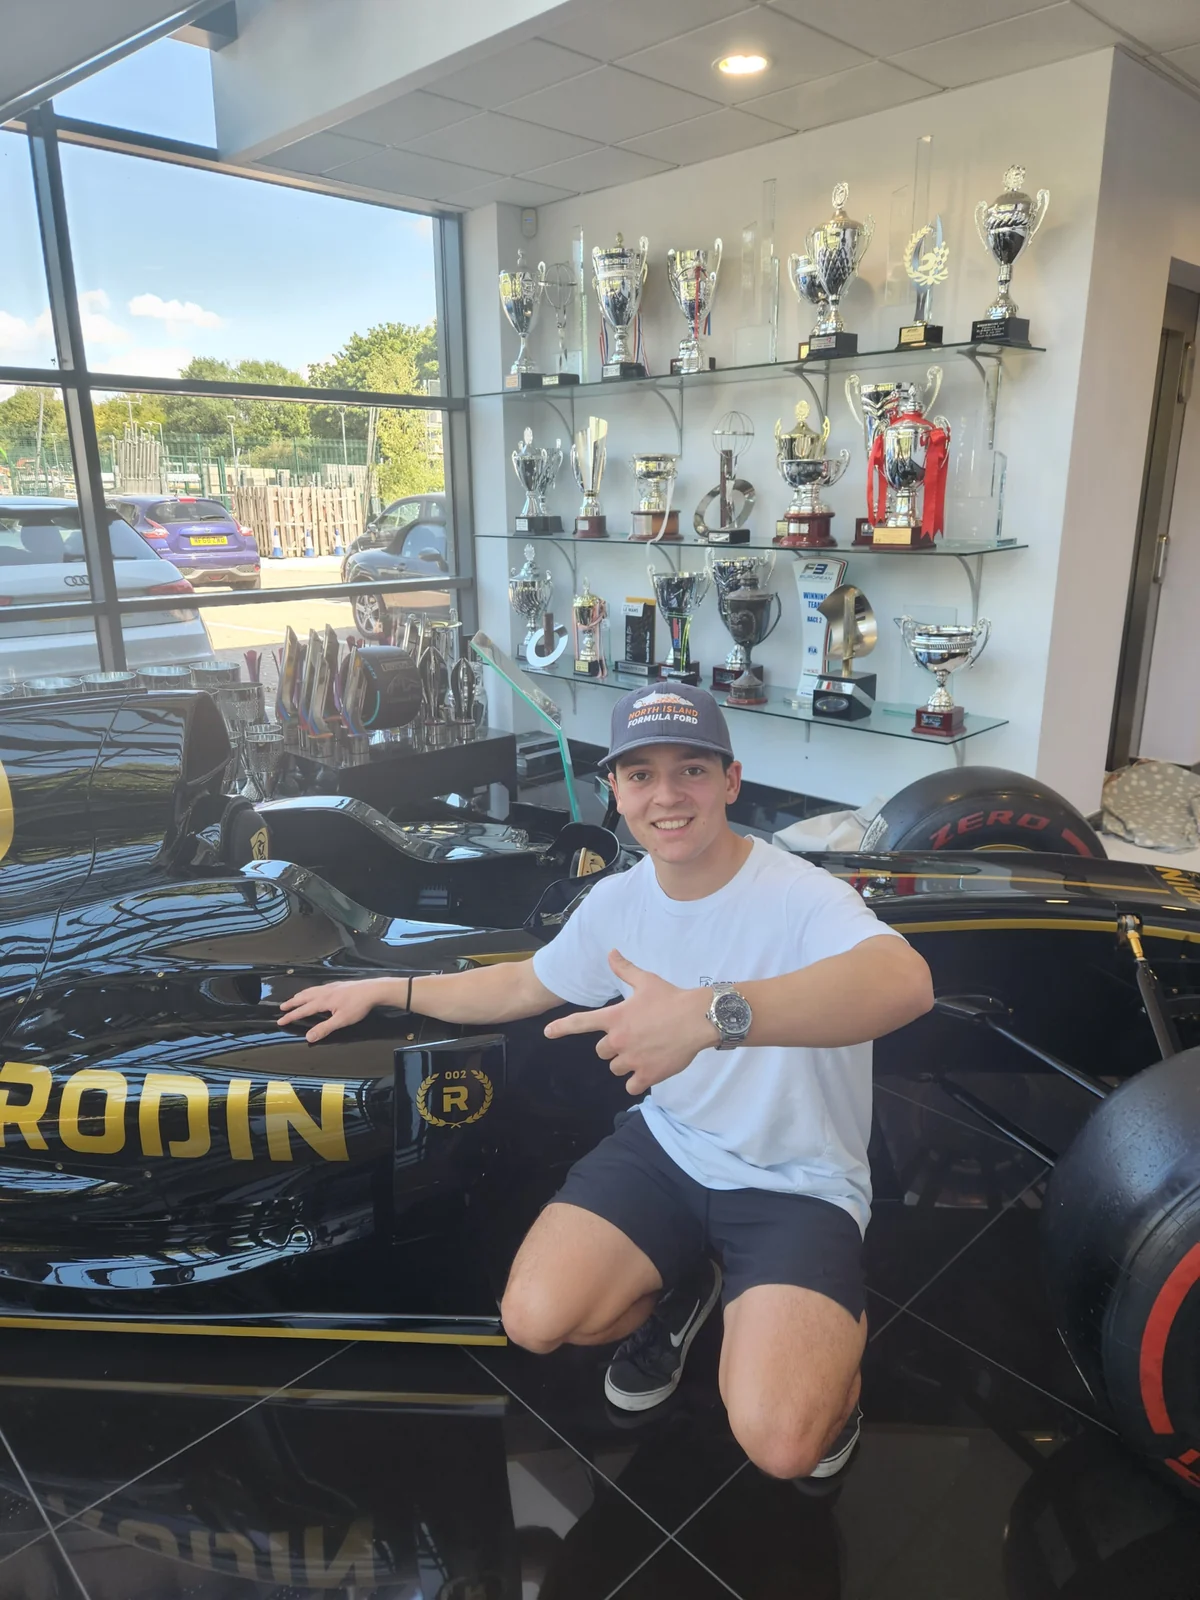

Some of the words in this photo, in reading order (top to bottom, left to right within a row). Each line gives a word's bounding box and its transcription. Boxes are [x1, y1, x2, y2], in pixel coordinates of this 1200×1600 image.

[801, 563, 829, 574] F3
[628, 707, 662, 720] NORTH
[662, 705, 699, 717] ISLAND
[627, 713, 671, 728] FORMULA
[673, 713, 698, 725] FORD
[929, 810, 1050, 850] ZERO
[445, 1070, 467, 1080] 002
[443, 1085, 469, 1113] R
[0, 1061, 350, 1161] RODIN
